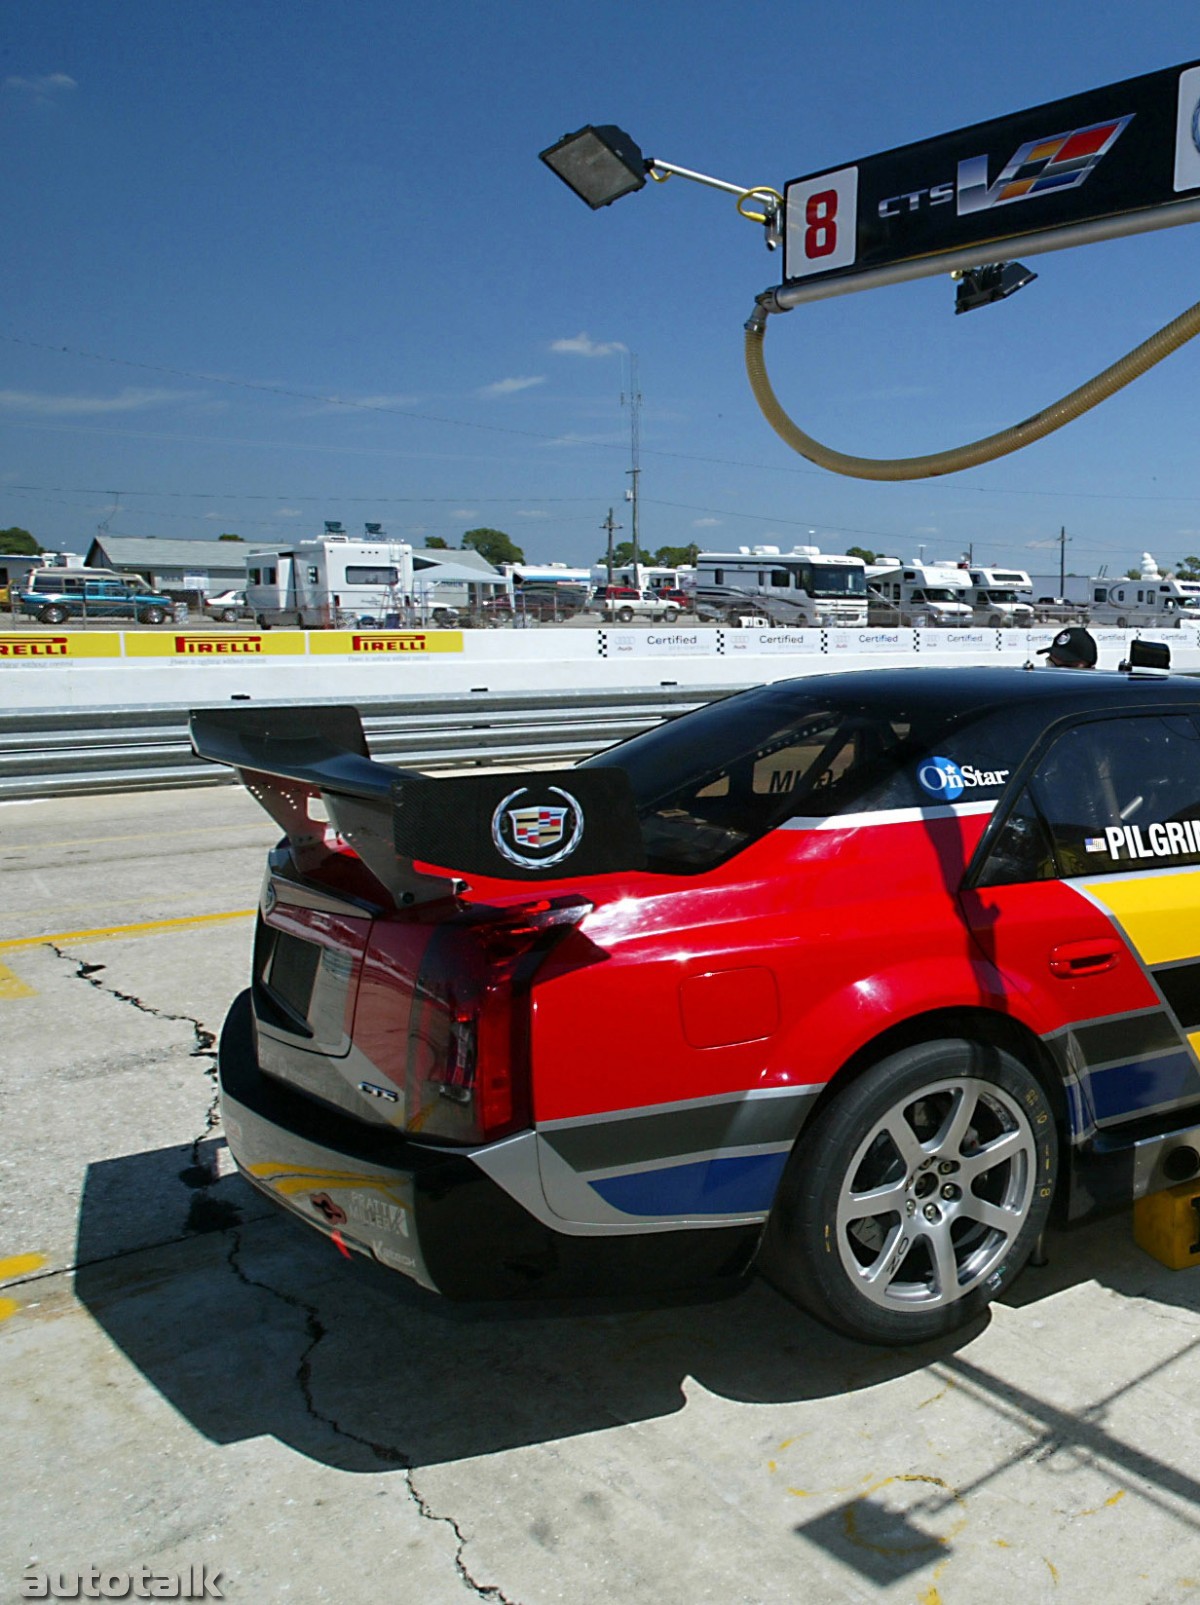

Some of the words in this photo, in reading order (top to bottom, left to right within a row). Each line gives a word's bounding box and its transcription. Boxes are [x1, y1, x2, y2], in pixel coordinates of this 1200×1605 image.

[804, 189, 838, 259] 8
[0, 637, 67, 655] RELLI
[175, 636, 261, 653] PIRELLI
[352, 635, 426, 650] PIRELLI
[647, 635, 697, 645] Certified
[760, 635, 804, 644] Certified
[859, 634, 898, 643] Certified
[948, 634, 983, 642] Certified
[919, 765, 1009, 790] OnStar
[358, 1082, 399, 1103] CTS
